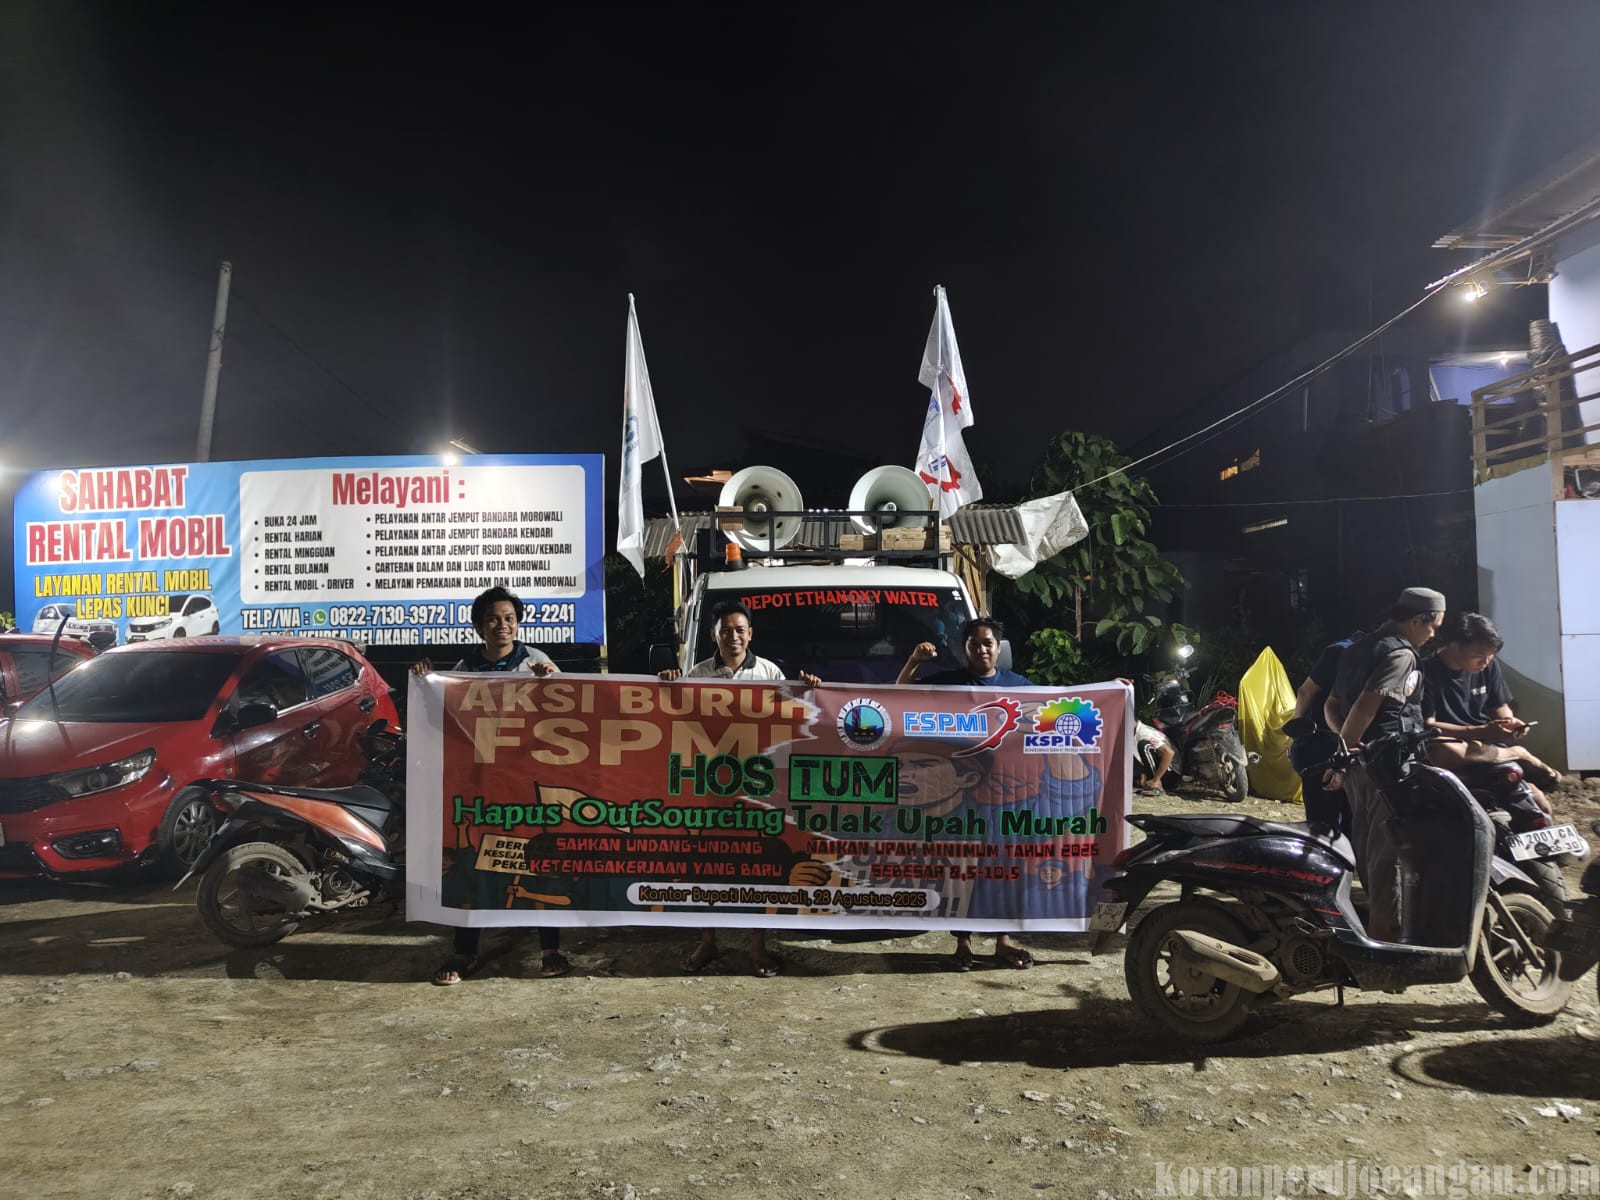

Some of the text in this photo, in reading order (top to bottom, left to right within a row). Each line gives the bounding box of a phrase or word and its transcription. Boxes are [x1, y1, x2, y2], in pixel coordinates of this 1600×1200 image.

[59, 467, 187, 512] SAHABAT
[332, 470, 450, 508] Melayani
[264, 515, 317, 527] BUKA 24 JAM
[375, 511, 563, 525] PELAYANAN ANTAR JEMPUT BANDARA MOROWALI
[28, 516, 231, 564] RENTAL MOBIL
[264, 531, 323, 543] RENTAL HARIAN
[375, 527, 553, 541] PELAYANAN ANTAR JEMPUT BANDARA KENDARI
[264, 547, 335, 559] RENTAL MINGGUAN
[375, 543, 572, 557] PELAYANAN ANTAR JEMPUT RSUD BUNGKU/KENDARI
[264, 563, 329, 576] RENTAL BULANAN
[375, 560, 551, 573] CARTERAN DALAM DAN LUAR KOTA MOROWALI
[35, 569, 213, 597] LAYANAN RENTAL MOBIL
[264, 580, 292, 592] RENTAL
[294, 579, 319, 591] MOBIL
[327, 578, 354, 590] DRIVER
[375, 576, 576, 589] MELAYANI PEMAKAIAN DALAM DAN LUAR MOROWALI
[76, 595, 170, 620] LEPAS KUNCI
[741, 593, 792, 610] DEPOT
[884, 590, 939, 607] WATER
[241, 608, 301, 629] TELP/WA
[329, 602, 447, 626] 0822-7130-3972
[352, 628, 420, 645] BELAKANG
[423, 627, 486, 645] PUSKES
[518, 626, 576, 644] AHODOPI
[459, 682, 811, 720] AKSI BURUH
[904, 712, 988, 732] FSPMI
[474, 717, 792, 768] FSPMI
[1025, 735, 1073, 747] KSPI
[668, 753, 895, 799] HOS TUM
[453, 795, 1108, 842] Hapus OutSourcing Tolak Upah Murah
[1526, 830, 1554, 844] 2001
[1558, 827, 1575, 839] CA
[484, 849, 524, 859] KESEJA
[556, 837, 763, 855] SAHKAN UNDANG-UNDANG
[806, 840, 870, 856] NAIKAN
[874, 841, 917, 857] UPAH
[922, 842, 999, 858] MINIMUM
[1004, 843, 1055, 858] TAHUN
[529, 859, 784, 878] KETENAGAKERJAAN YANG BARU
[870, 864, 945, 879] SEBESAR
[638, 885, 691, 902] Kantor
[691, 886, 739, 905] Bupati
[813, 889, 832, 905] 28
[832, 889, 892, 907] Agustus
[892, 891, 927, 907] 2025
